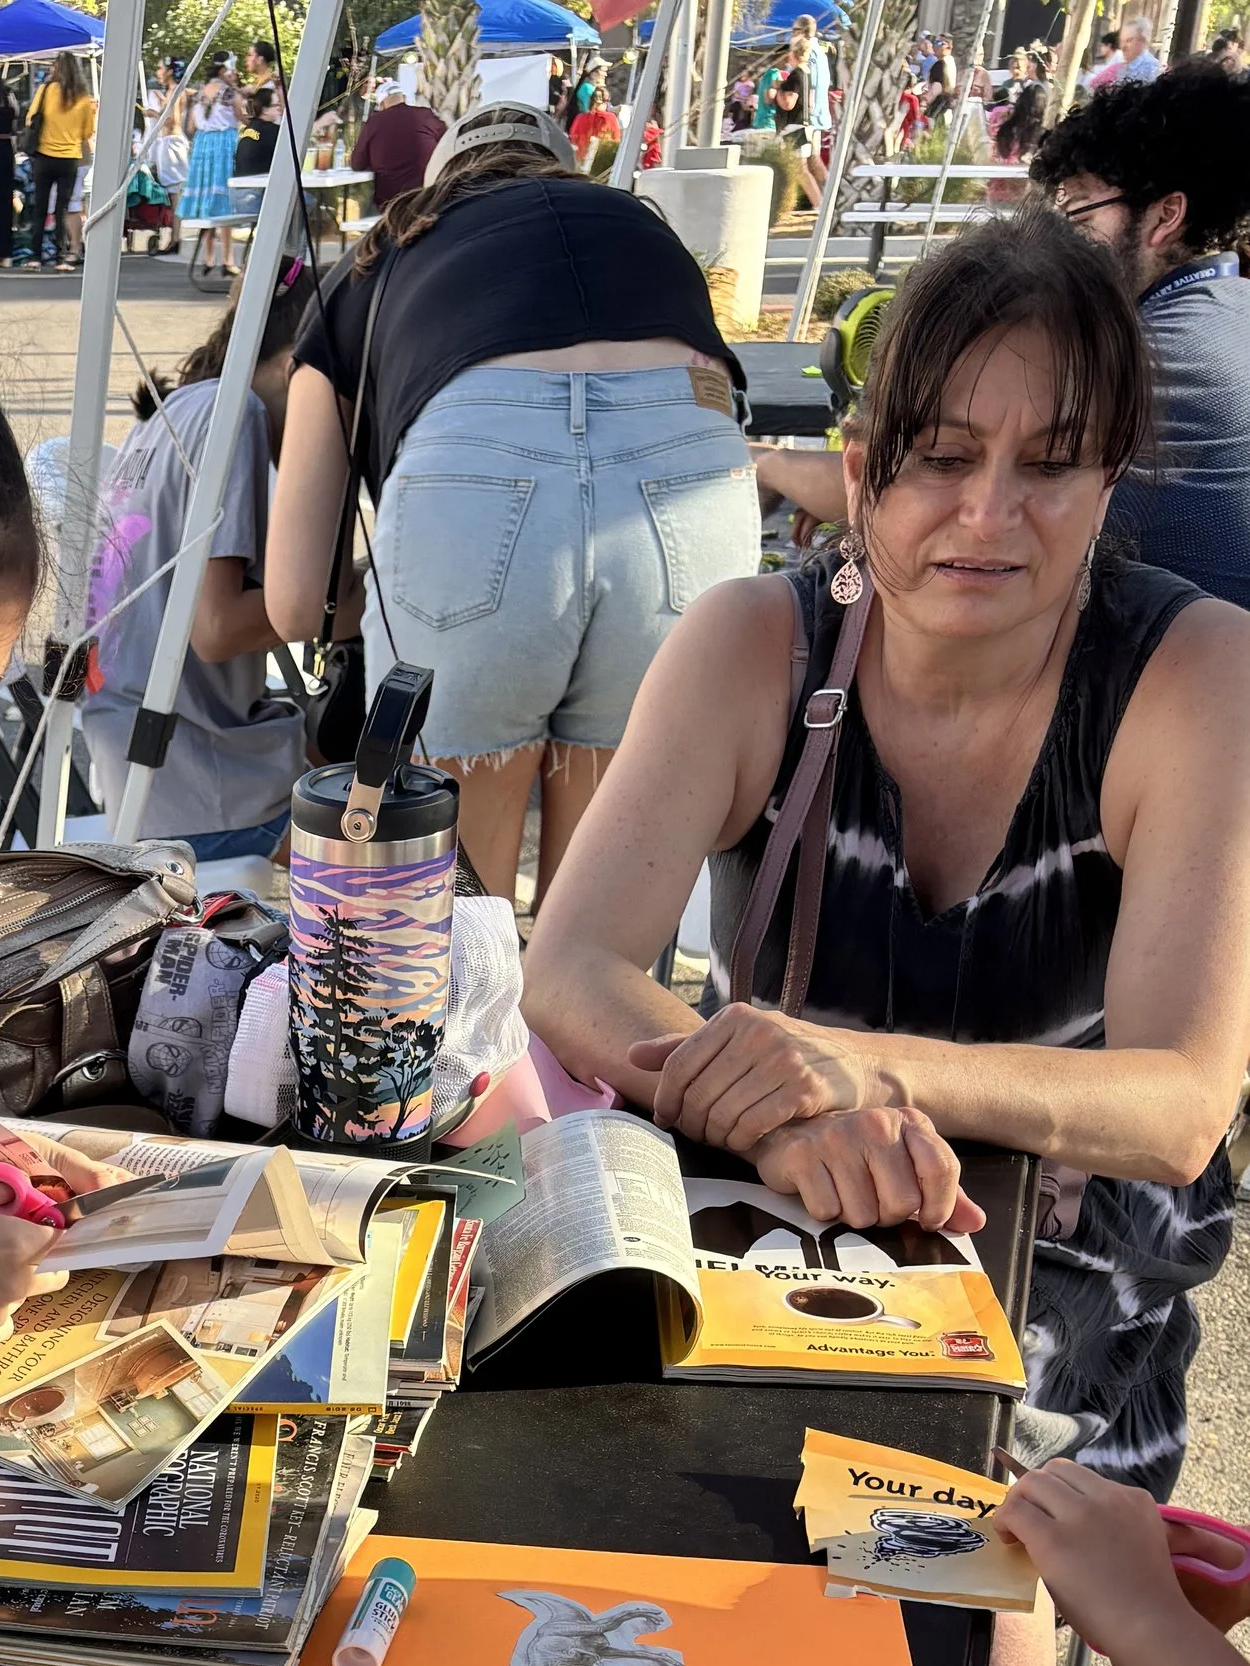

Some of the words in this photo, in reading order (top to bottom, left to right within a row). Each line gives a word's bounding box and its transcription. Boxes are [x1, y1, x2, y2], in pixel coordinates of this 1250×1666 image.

[155, 939, 178, 985] MAN
[60, 1271, 112, 1309] KITCHEN
[758, 1268, 821, 1283] Your
[833, 1275, 897, 1290] way.
[25, 1293, 54, 1316] ONE
[33, 1309, 61, 1333] AND
[47, 1293, 109, 1351] DESIGNING
[807, 1343, 896, 1358] Advantage
[7, 1351, 47, 1384] YOUR
[302, 1419, 326, 1474] FRANCIS
[179, 1450, 220, 1529] NATIONAL
[223, 1466, 237, 1499] PREPARED
[293, 1473, 314, 1511] SCOTT
[847, 1467, 923, 1498] Your
[220, 1511, 230, 1524] THE
[254, 1592, 279, 1631] PATRIOT
